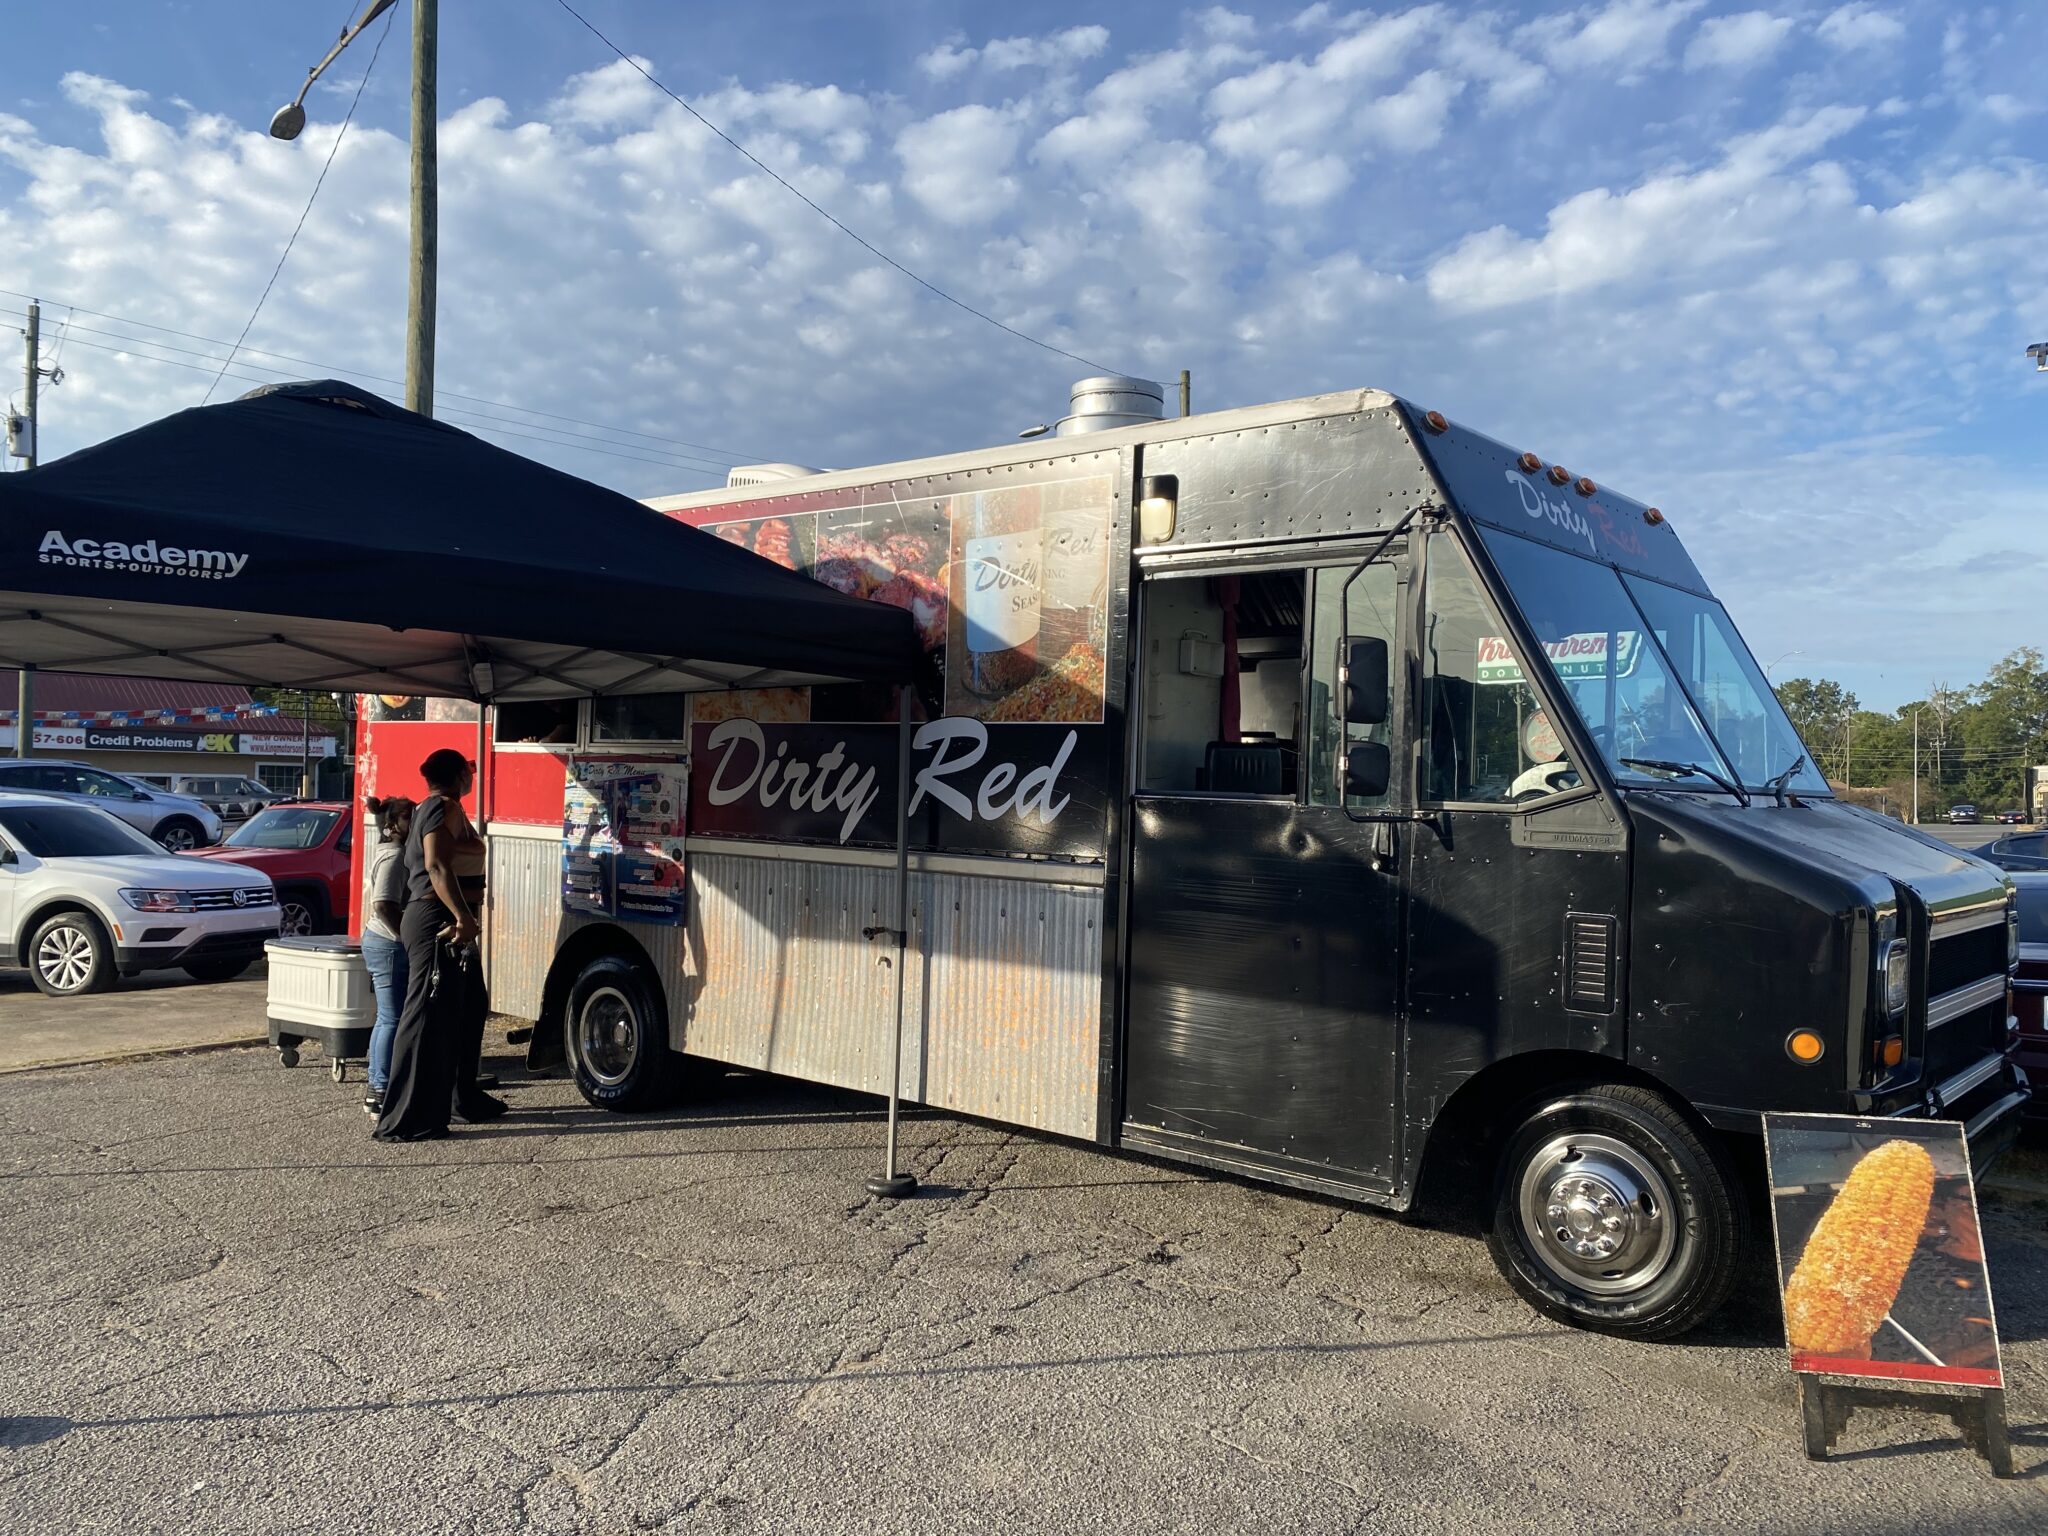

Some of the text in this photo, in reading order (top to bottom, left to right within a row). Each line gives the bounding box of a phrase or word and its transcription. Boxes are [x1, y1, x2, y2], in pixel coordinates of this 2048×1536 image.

[1505, 469, 1648, 560] Dirty Red
[38, 530, 249, 578] Academy
[38, 553, 223, 580] SPORTS+OUTDOORS
[89, 734, 130, 746] Credit
[133, 736, 193, 748] Problems
[273, 735, 322, 743] OWNERHIP
[707, 718, 880, 845] Dirty
[908, 715, 1078, 825] Red
